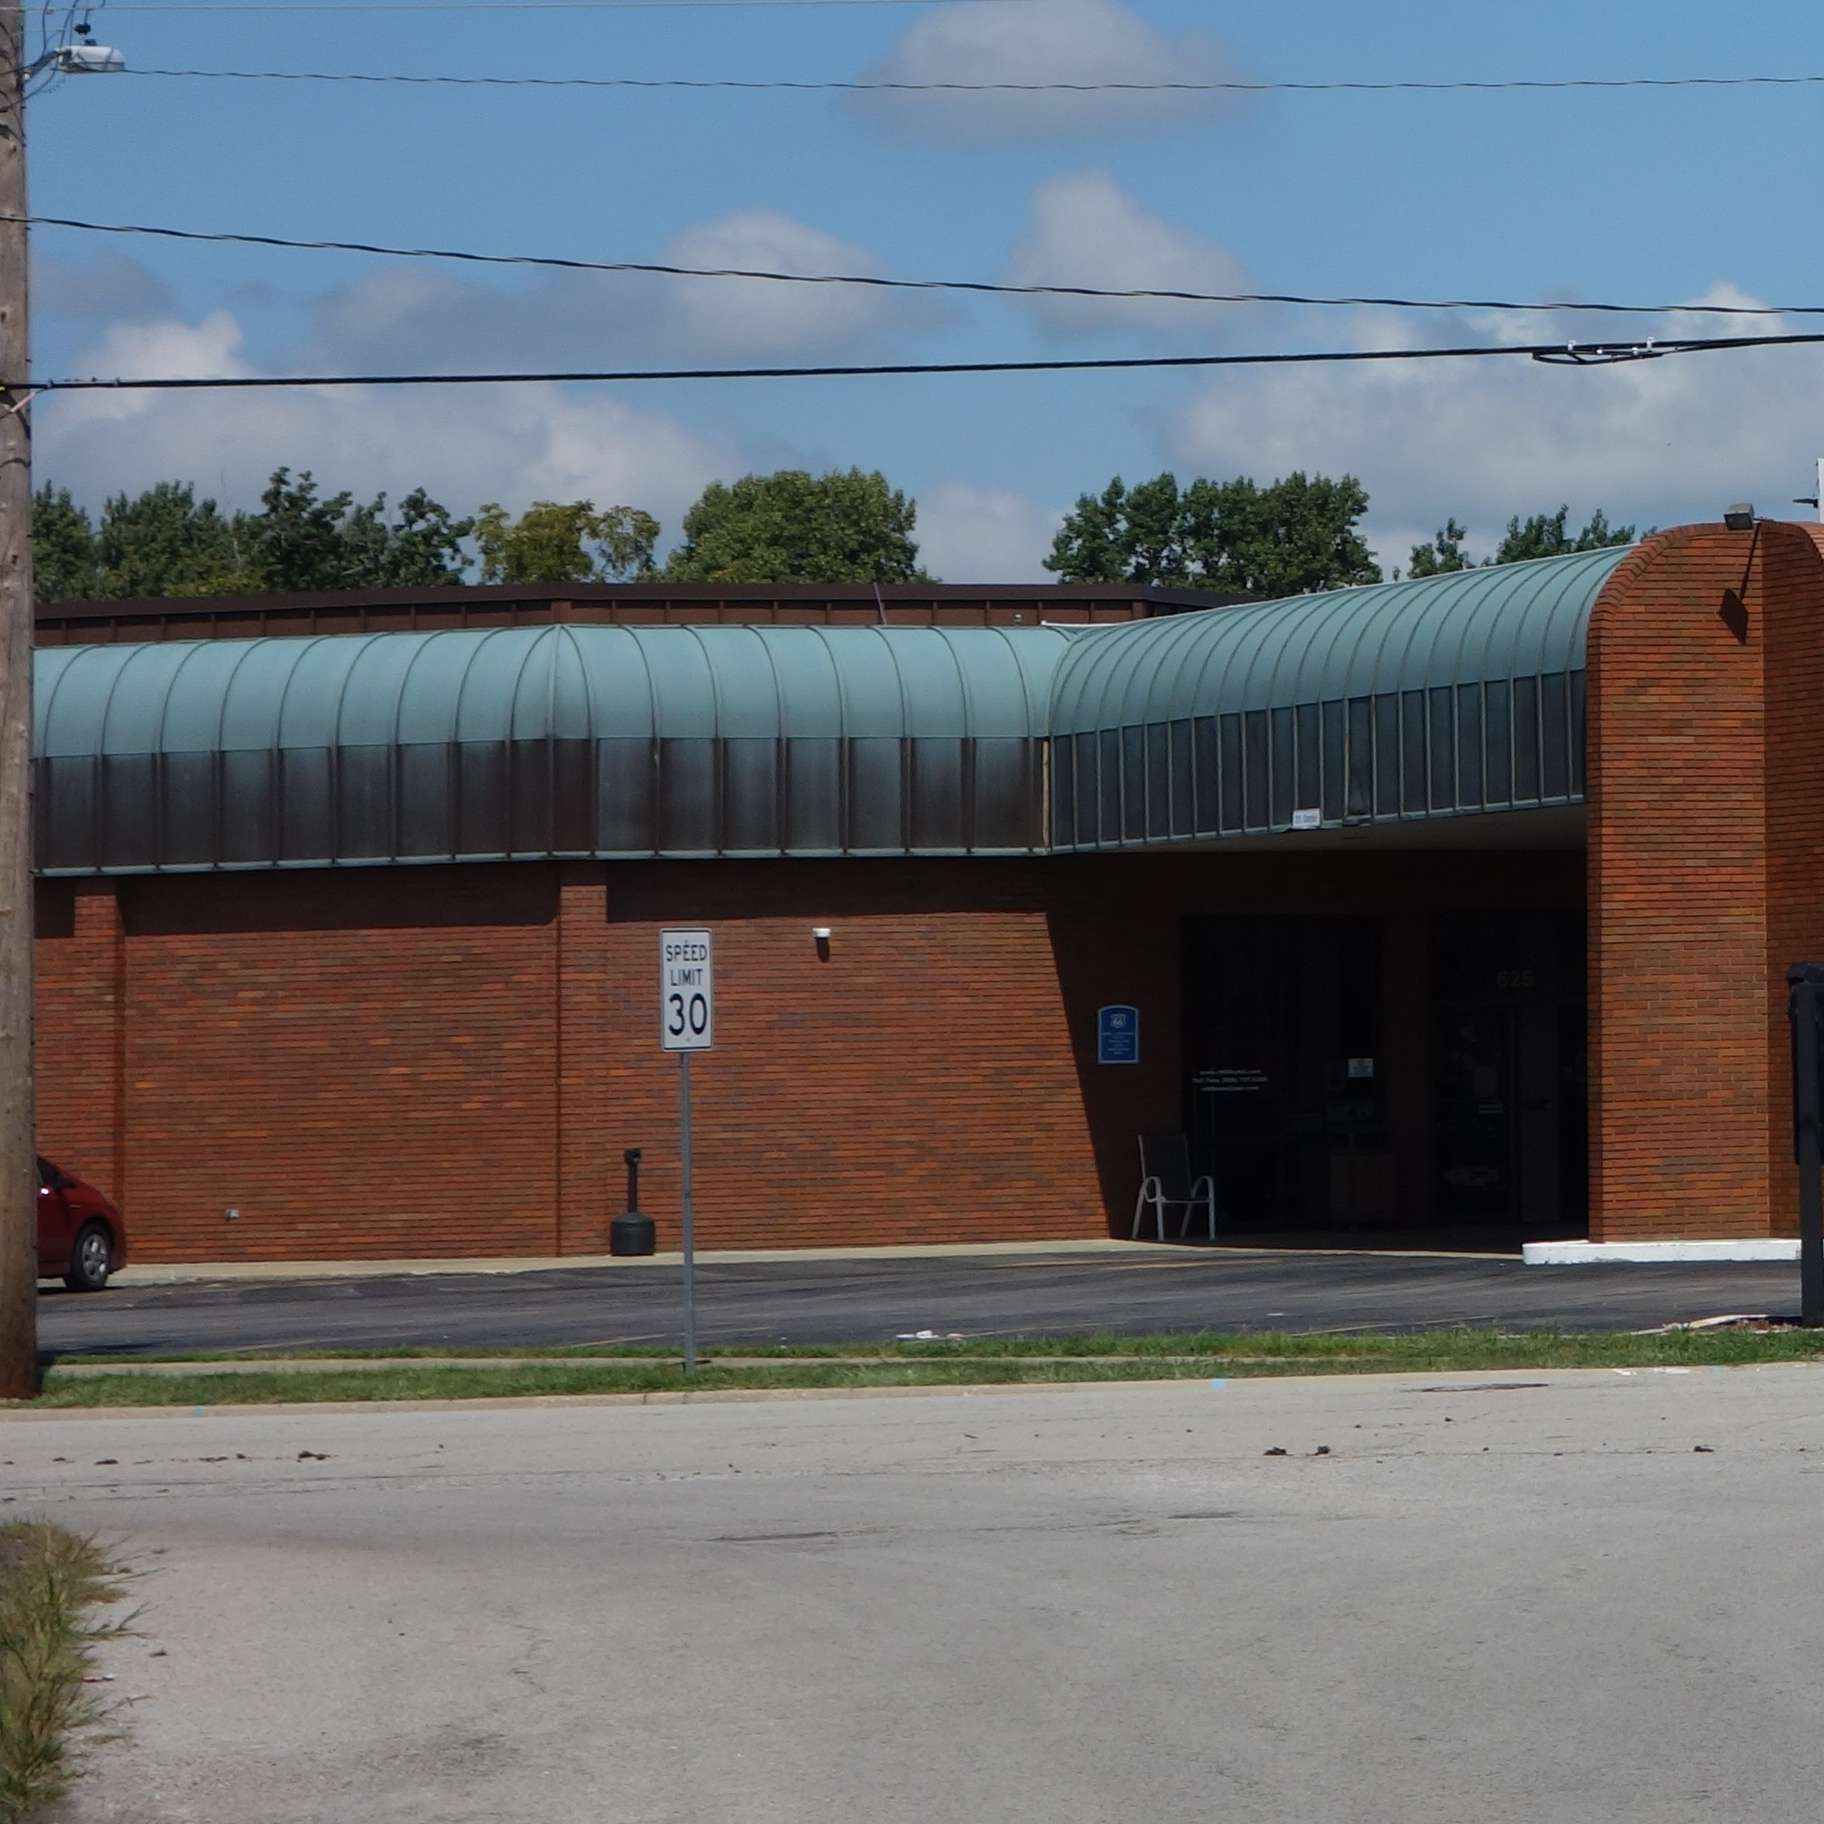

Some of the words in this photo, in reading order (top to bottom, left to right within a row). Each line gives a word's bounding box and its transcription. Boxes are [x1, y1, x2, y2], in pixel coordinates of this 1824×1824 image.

[665, 943, 708, 962] SPEED
[670, 968, 703, 986] LIMIT
[667, 992, 708, 1036] 30
